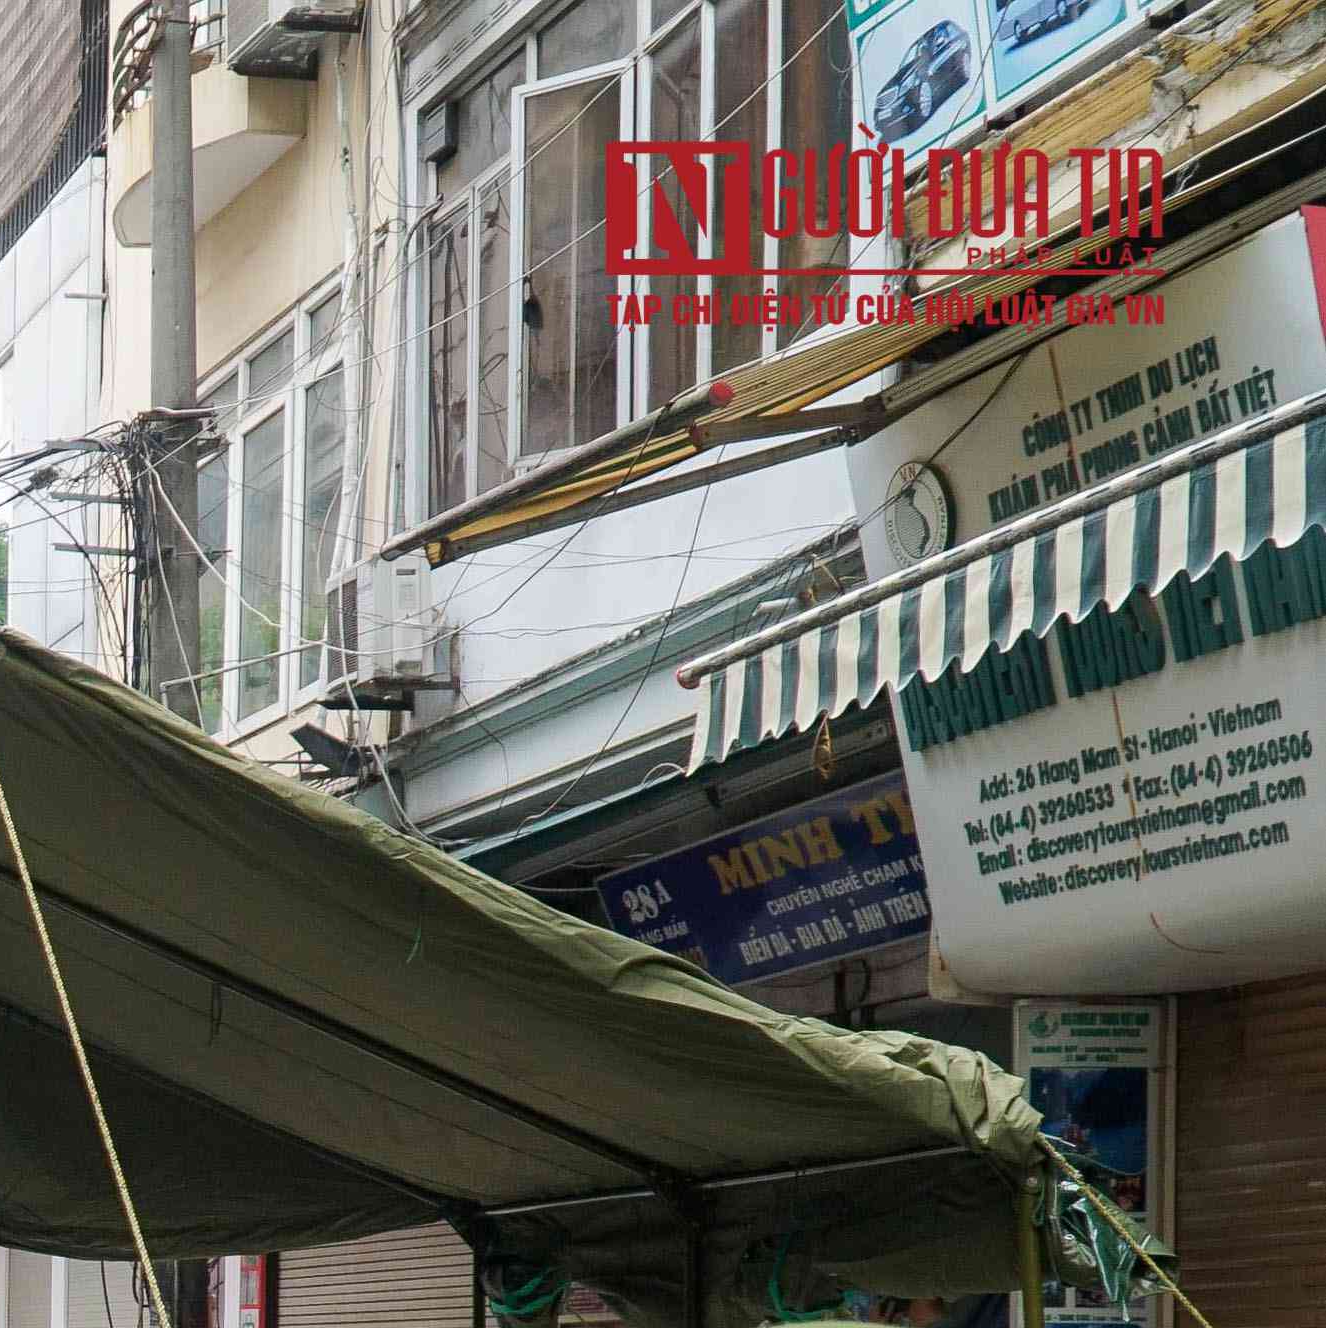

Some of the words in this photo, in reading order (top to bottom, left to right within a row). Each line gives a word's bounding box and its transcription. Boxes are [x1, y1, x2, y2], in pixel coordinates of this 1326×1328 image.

[1022, 411, 1071, 457] CÔNG
[1070, 396, 1093, 436] TY
[1096, 372, 1145, 423] TNHH
[1146, 358, 1174, 401] DU
[1175, 336, 1220, 389] LỊCH
[1080, 429, 1142, 485] PHONG
[1143, 406, 1195, 456] CẢNH
[1016, 765, 1036, 793] 26
[1037, 757, 1081, 785] Hang
[1148, 712, 1199, 755] Hanoi
[1207, 698, 1283, 738] Vietnam
[1225, 730, 1313, 778] 39260506
[707, 815, 845, 896] MINH
